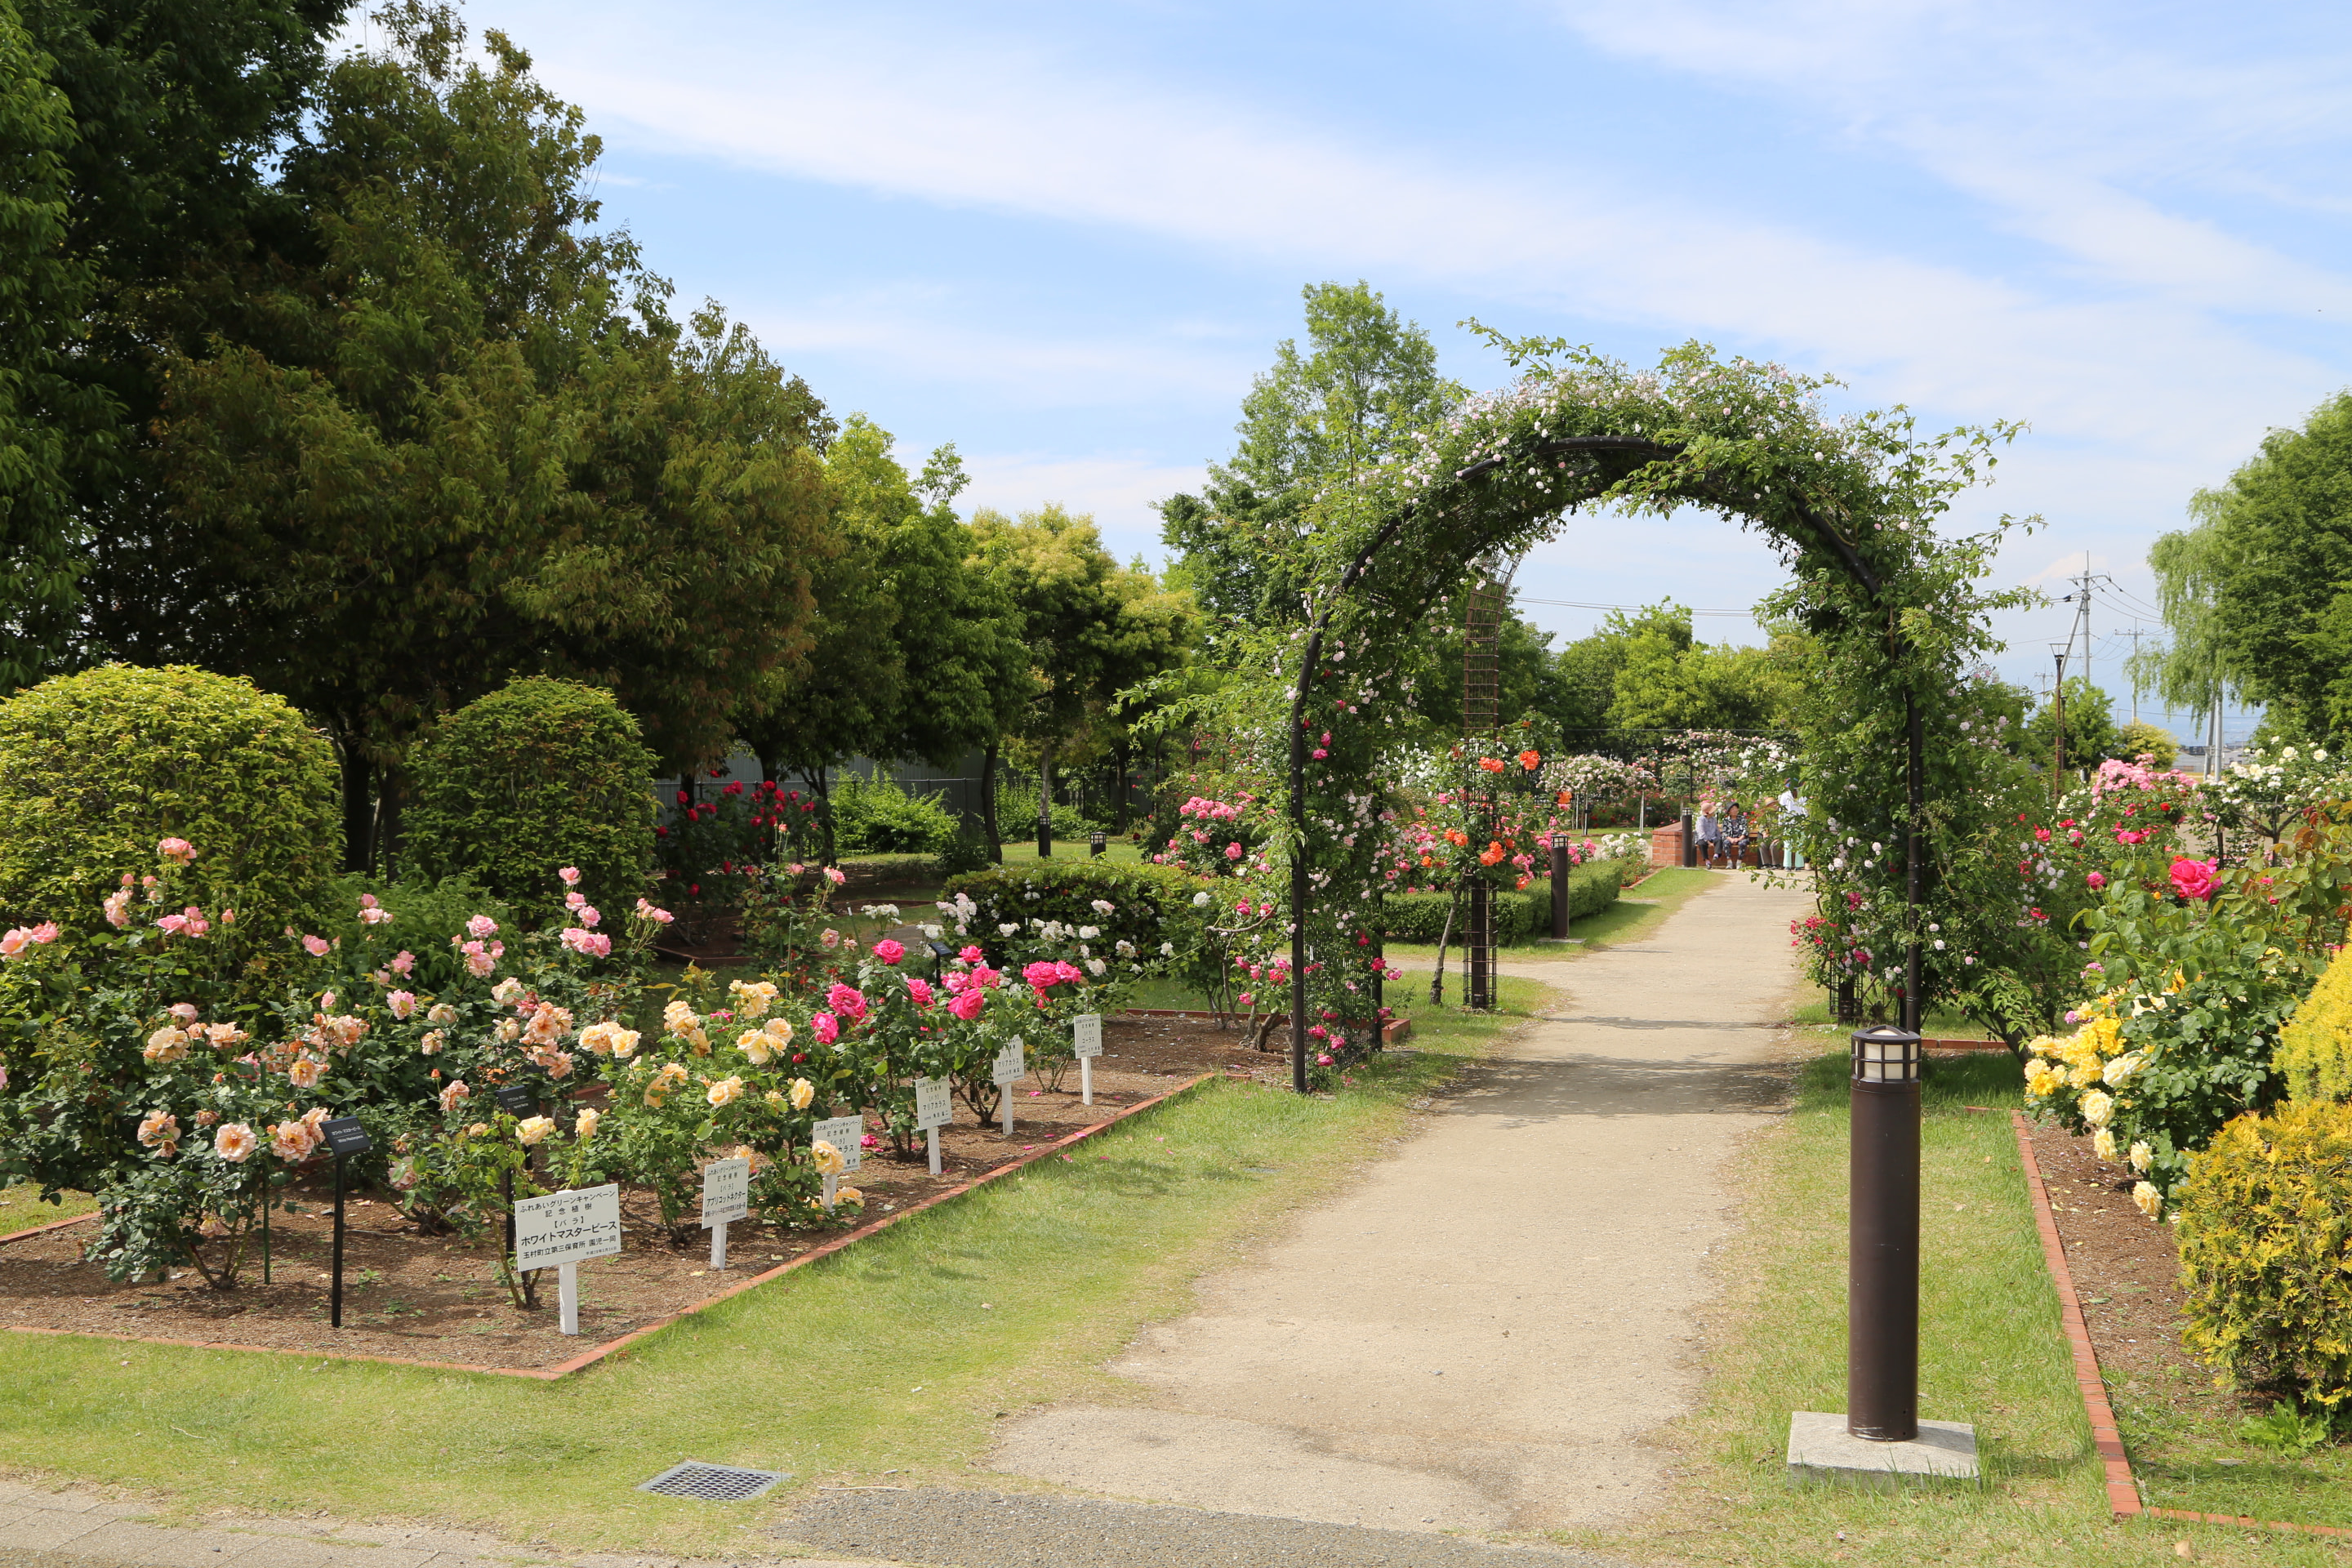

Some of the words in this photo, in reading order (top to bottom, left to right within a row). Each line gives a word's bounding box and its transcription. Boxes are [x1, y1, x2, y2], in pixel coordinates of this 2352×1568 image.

[998, 1058, 1019, 1067] マリアカラス
[923, 1099, 946, 1111] マリアカラス
[816, 1120, 862, 1131] ふれあいグリーンキャンペーン
[707, 1162, 748, 1176] ふれあいグリーンキャンペーン
[519, 1190, 616, 1214] ふれあいグリーンキャンペーン
[706, 1191, 746, 1207] アプリコットネクター
[545, 1202, 592, 1218] 記念植樹
[521, 1221, 617, 1246] ホワイトマスターピース
[523, 1241, 586, 1259] 玉村町立第三保育所
[588, 1235, 617, 1247] 園児一同
